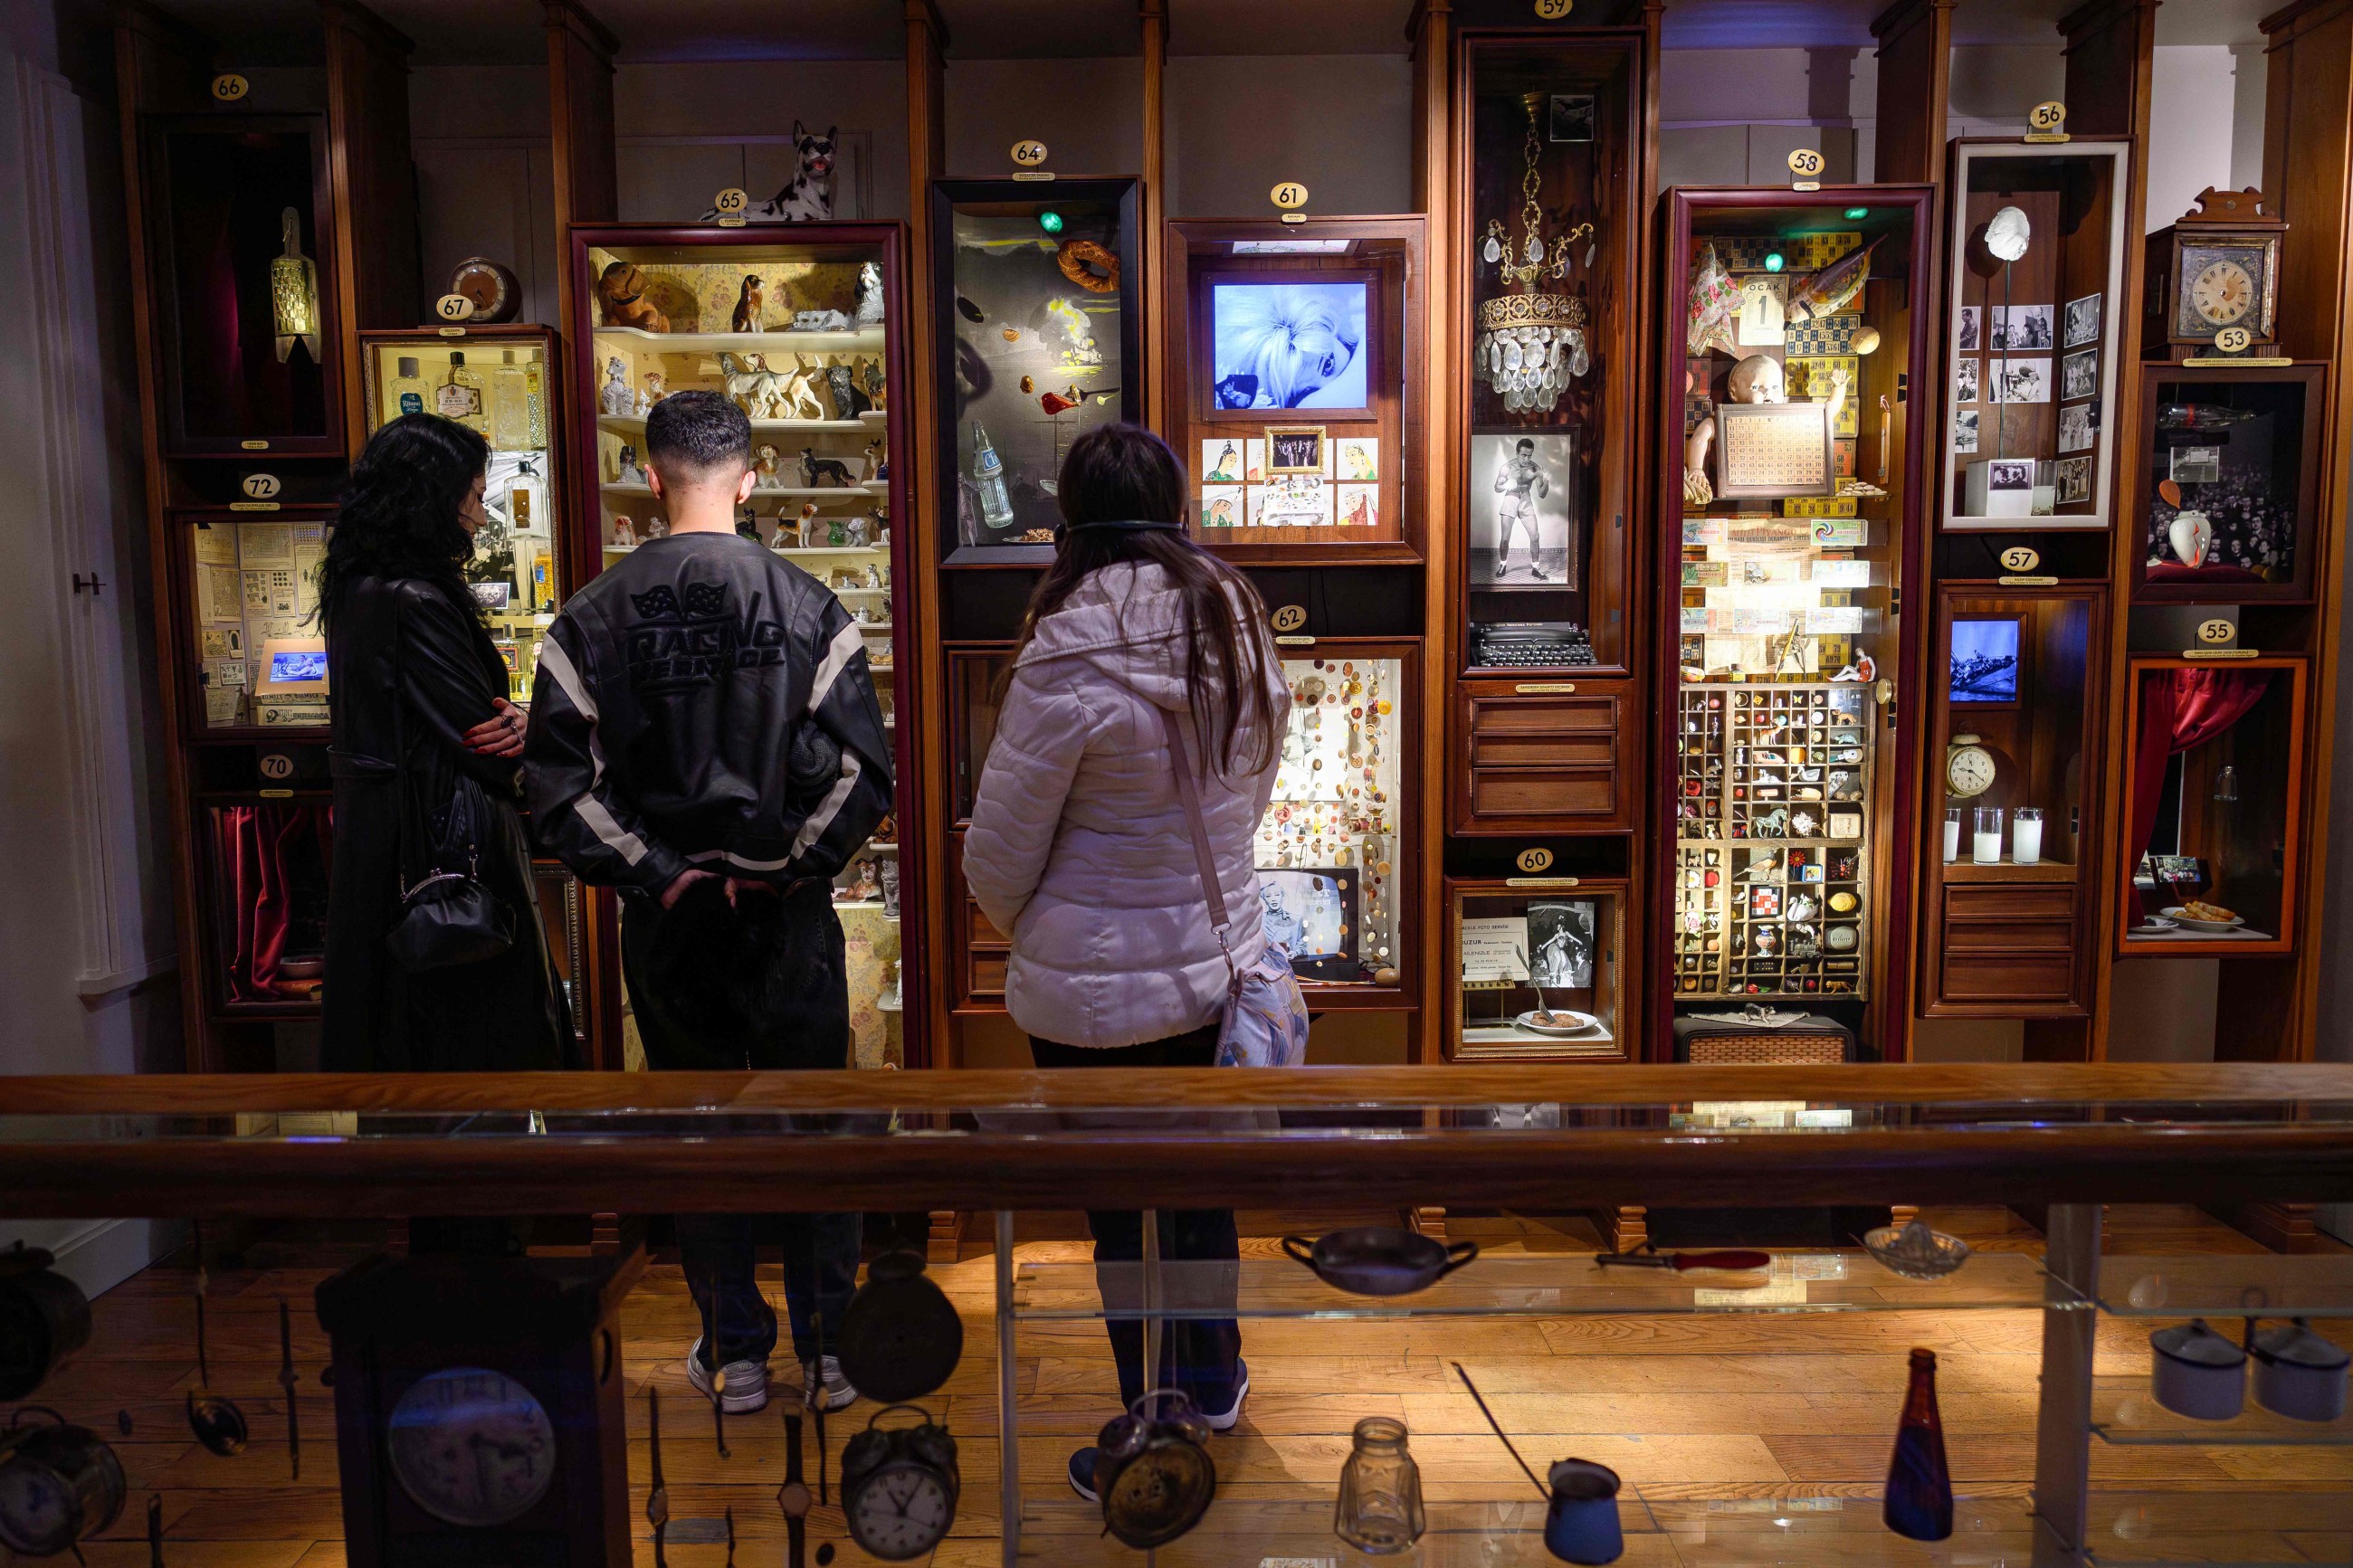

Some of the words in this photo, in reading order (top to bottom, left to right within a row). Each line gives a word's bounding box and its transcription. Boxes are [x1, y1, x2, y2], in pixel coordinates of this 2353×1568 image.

[1544, 0, 1565, 14] 59
[219, 79, 240, 95] 66
[2038, 106, 2060, 125] 56
[1017, 145, 1039, 160] 64
[1795, 152, 1818, 171] 58
[719, 192, 740, 209] 65
[1280, 187, 1296, 203] 61
[444, 299, 464, 316] 67
[1758, 296, 1767, 325] 1
[2224, 330, 2245, 348] 53
[250, 479, 272, 496] 72
[2009, 553, 2033, 566] 57
[1280, 608, 1300, 626] 62
[627, 591, 786, 663] RACING
[2206, 624, 2227, 639] 55
[267, 758, 287, 774] 70
[1525, 852, 1547, 869] 60
